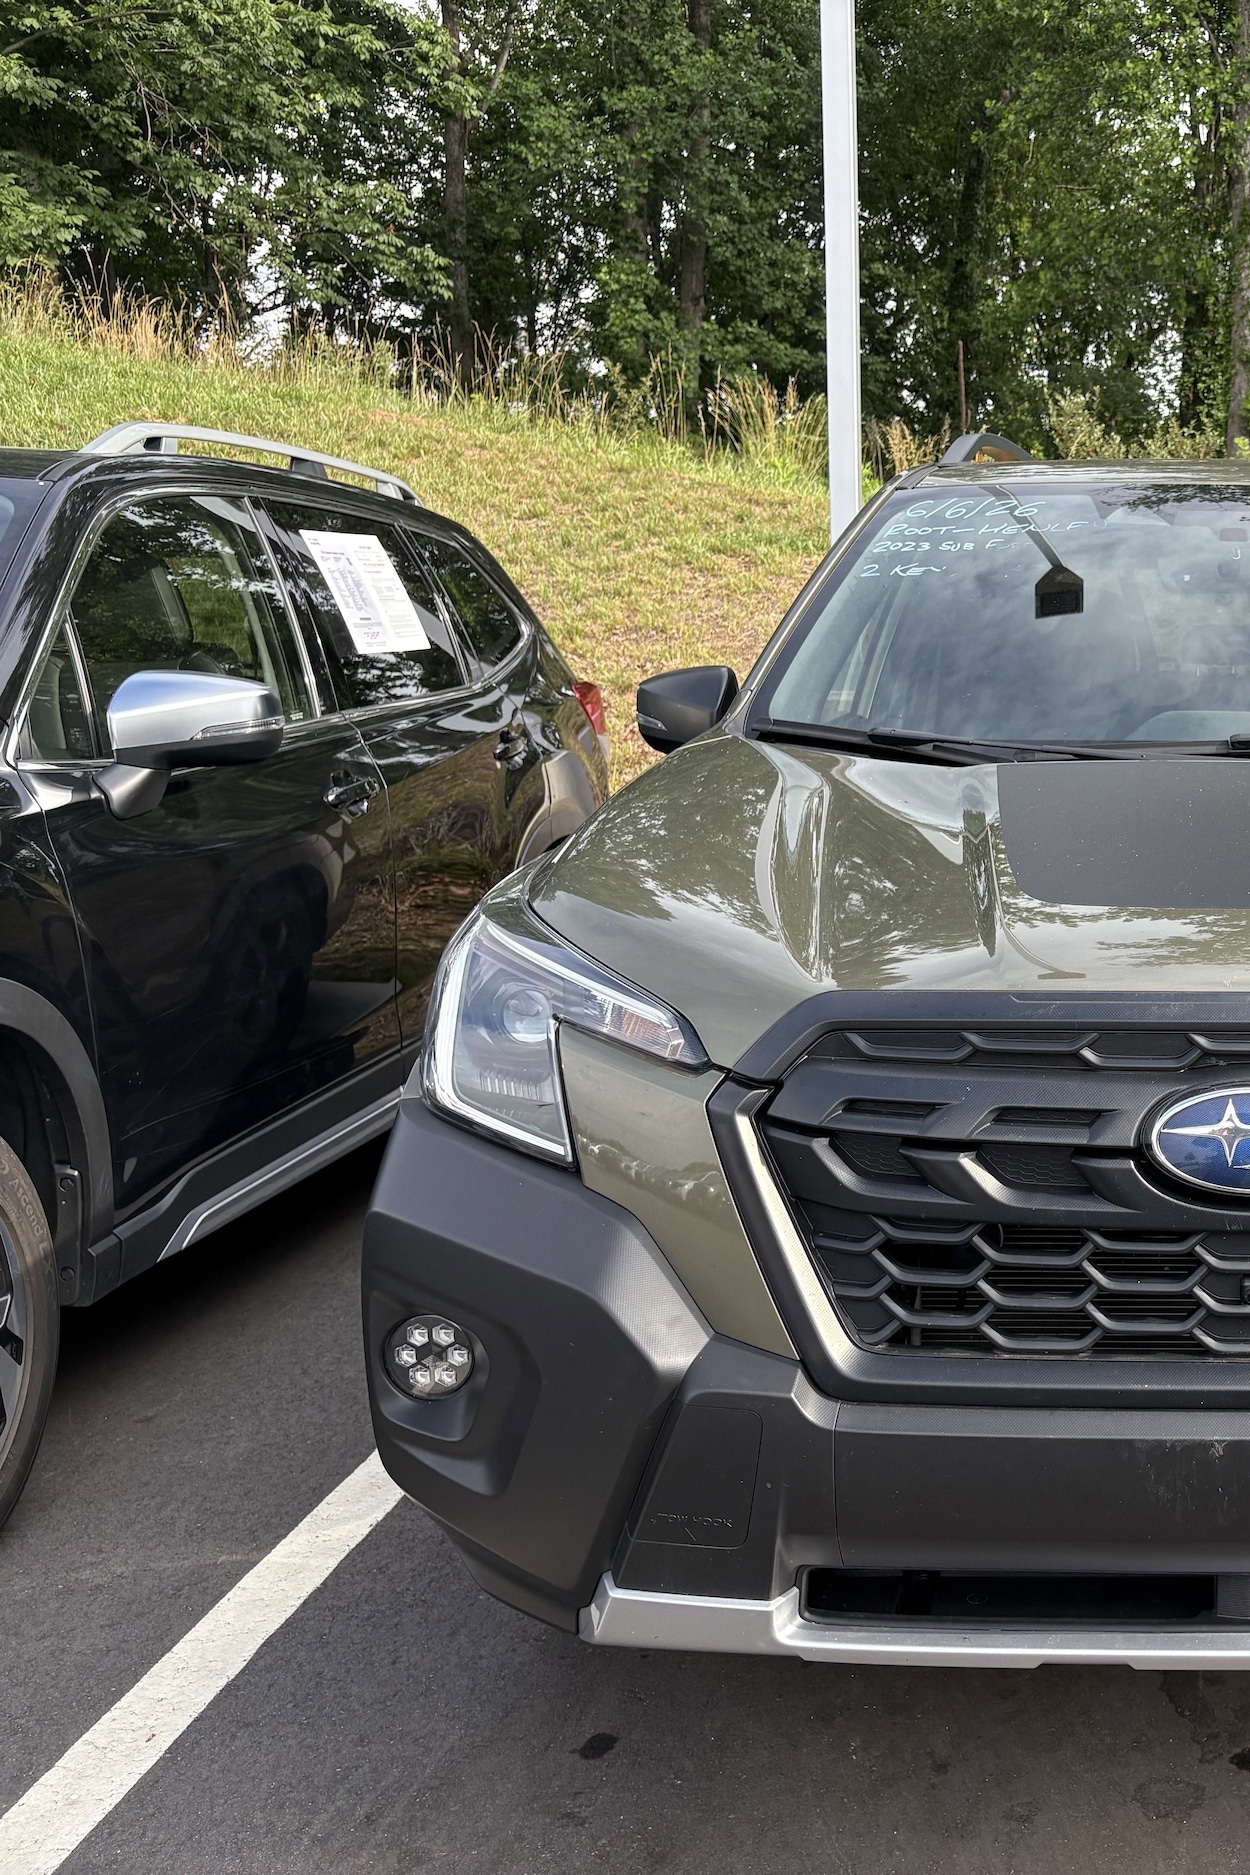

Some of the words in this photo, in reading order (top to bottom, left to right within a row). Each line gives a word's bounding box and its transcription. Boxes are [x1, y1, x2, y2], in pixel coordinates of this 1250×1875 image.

[906, 497, 1046, 518] 6/6/26
[872, 541, 931, 553] 2023
[939, 541, 975, 552] SUB
[860, 564, 881, 578] 2
[9, 1178, 43, 1236] Ascend
